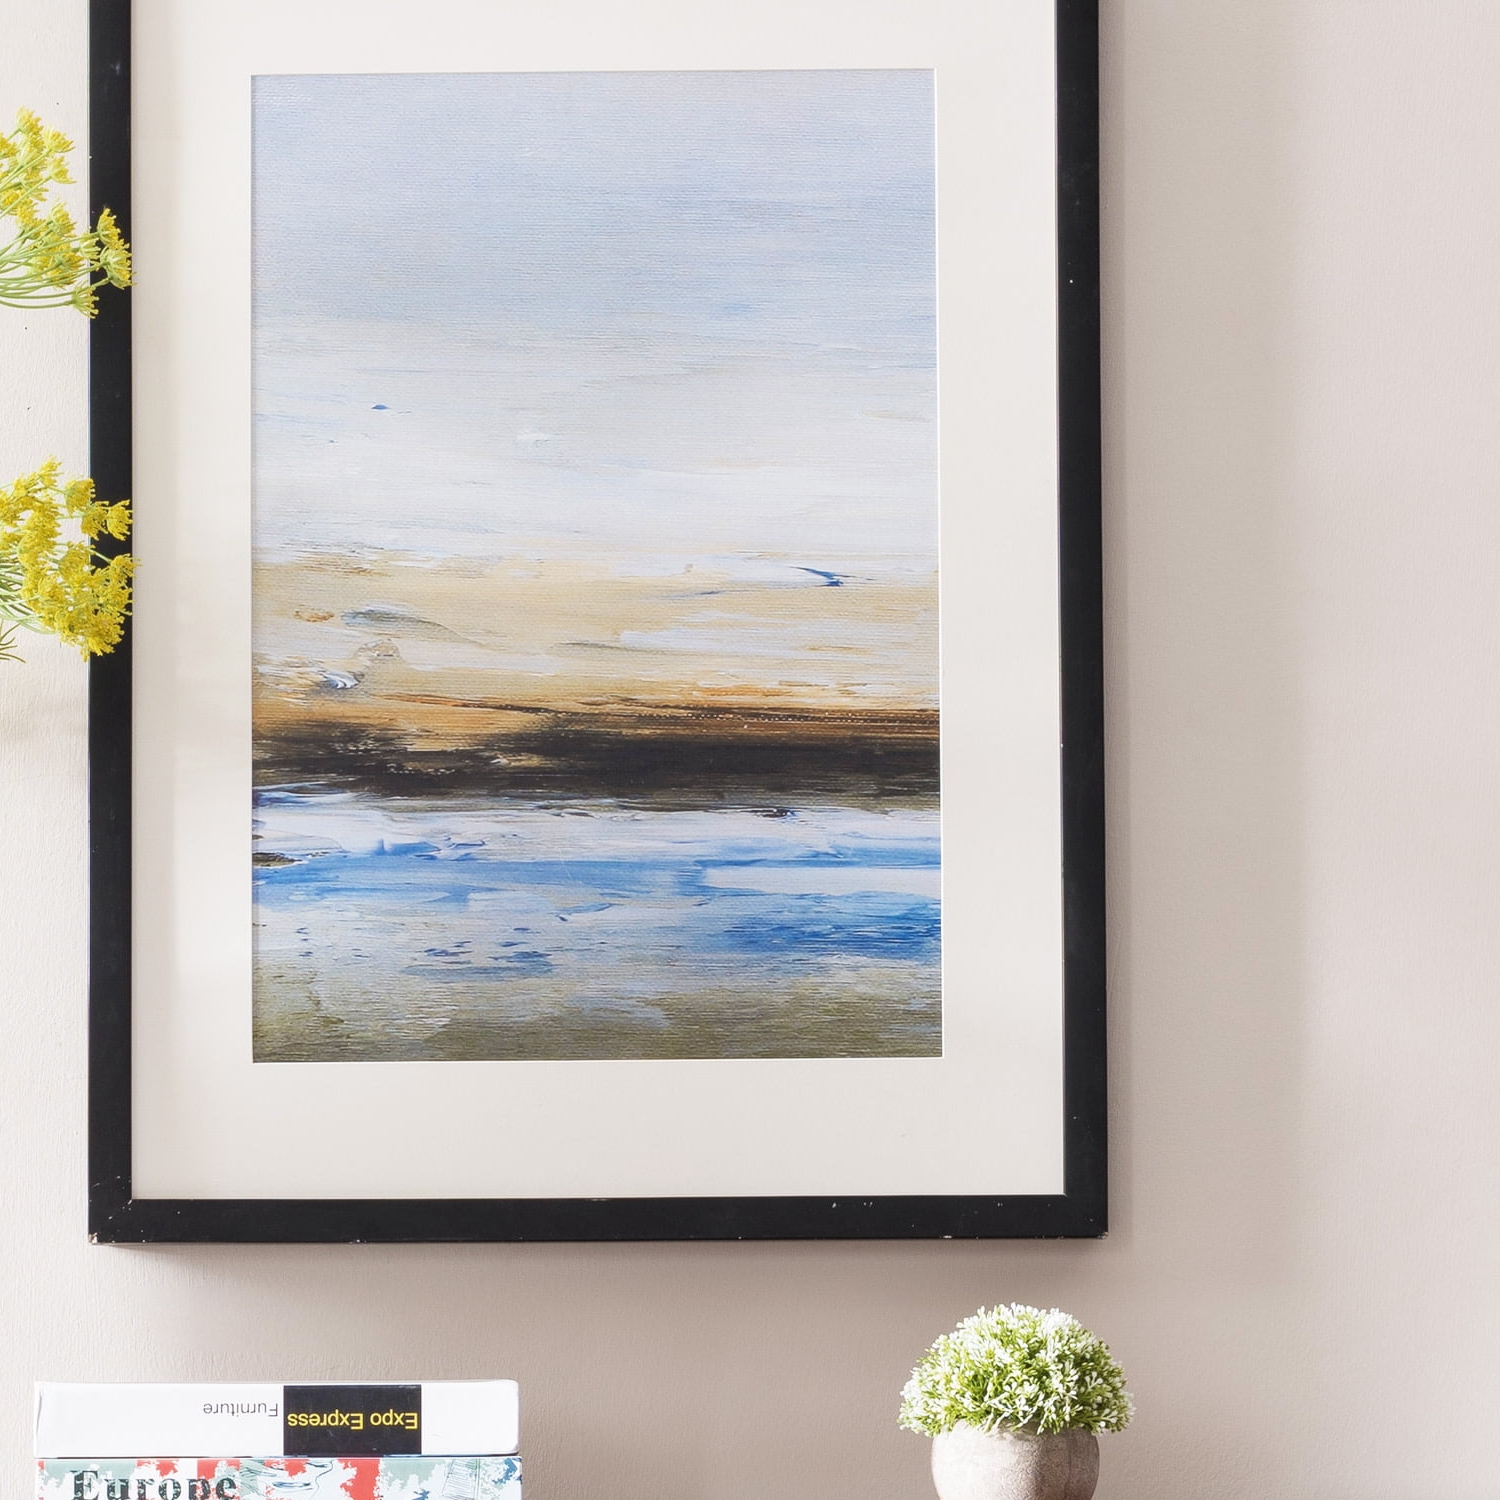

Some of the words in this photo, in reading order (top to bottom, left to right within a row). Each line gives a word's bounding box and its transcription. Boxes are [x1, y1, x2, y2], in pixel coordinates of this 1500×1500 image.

[202, 1402, 279, 1418] Furniture
[287, 1409, 364, 1430] Express
[370, 1409, 419, 1430] Expo
